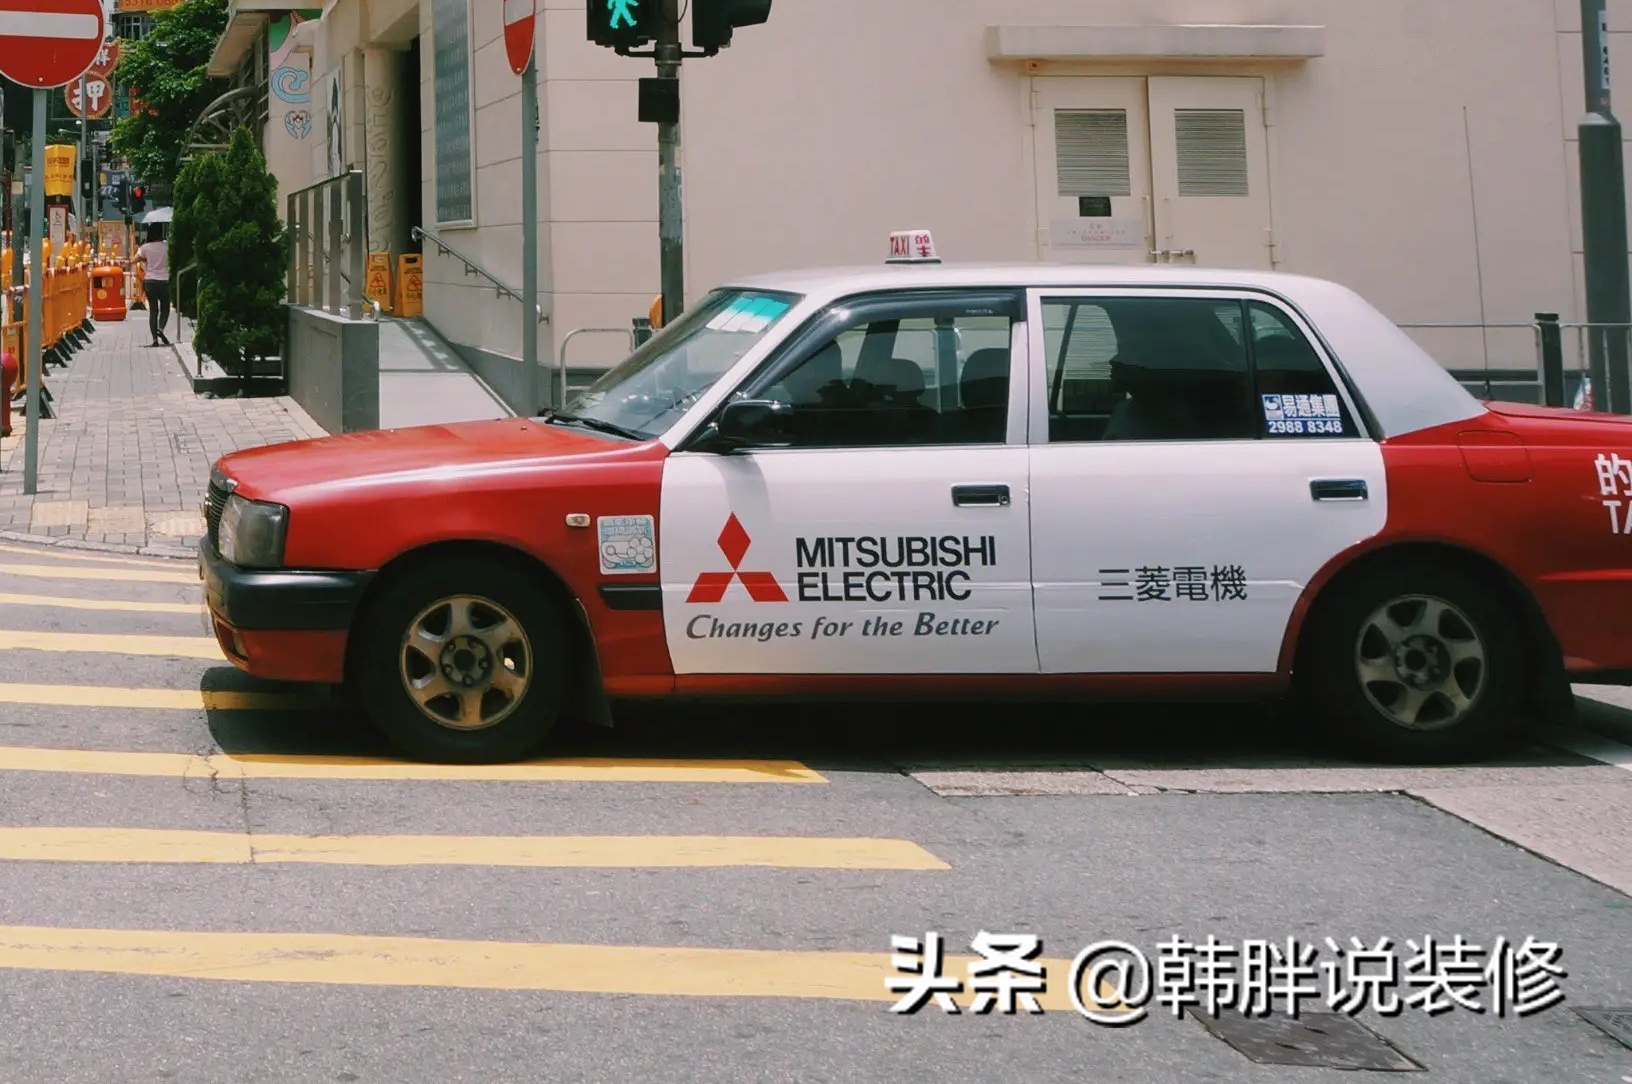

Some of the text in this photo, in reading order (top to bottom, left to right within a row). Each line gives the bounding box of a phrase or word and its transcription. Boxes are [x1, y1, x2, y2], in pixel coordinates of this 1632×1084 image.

[71, 78, 106, 112] 押
[889, 236, 910, 256] TAXI
[1269, 421, 1343, 434] 2988 8348
[795, 535, 997, 567] MITSUBISHI
[797, 569, 972, 602] ELECTRIC
[1098, 565, 1248, 602] 三菱電機
[686, 612, 1000, 642] Changes for the Better
